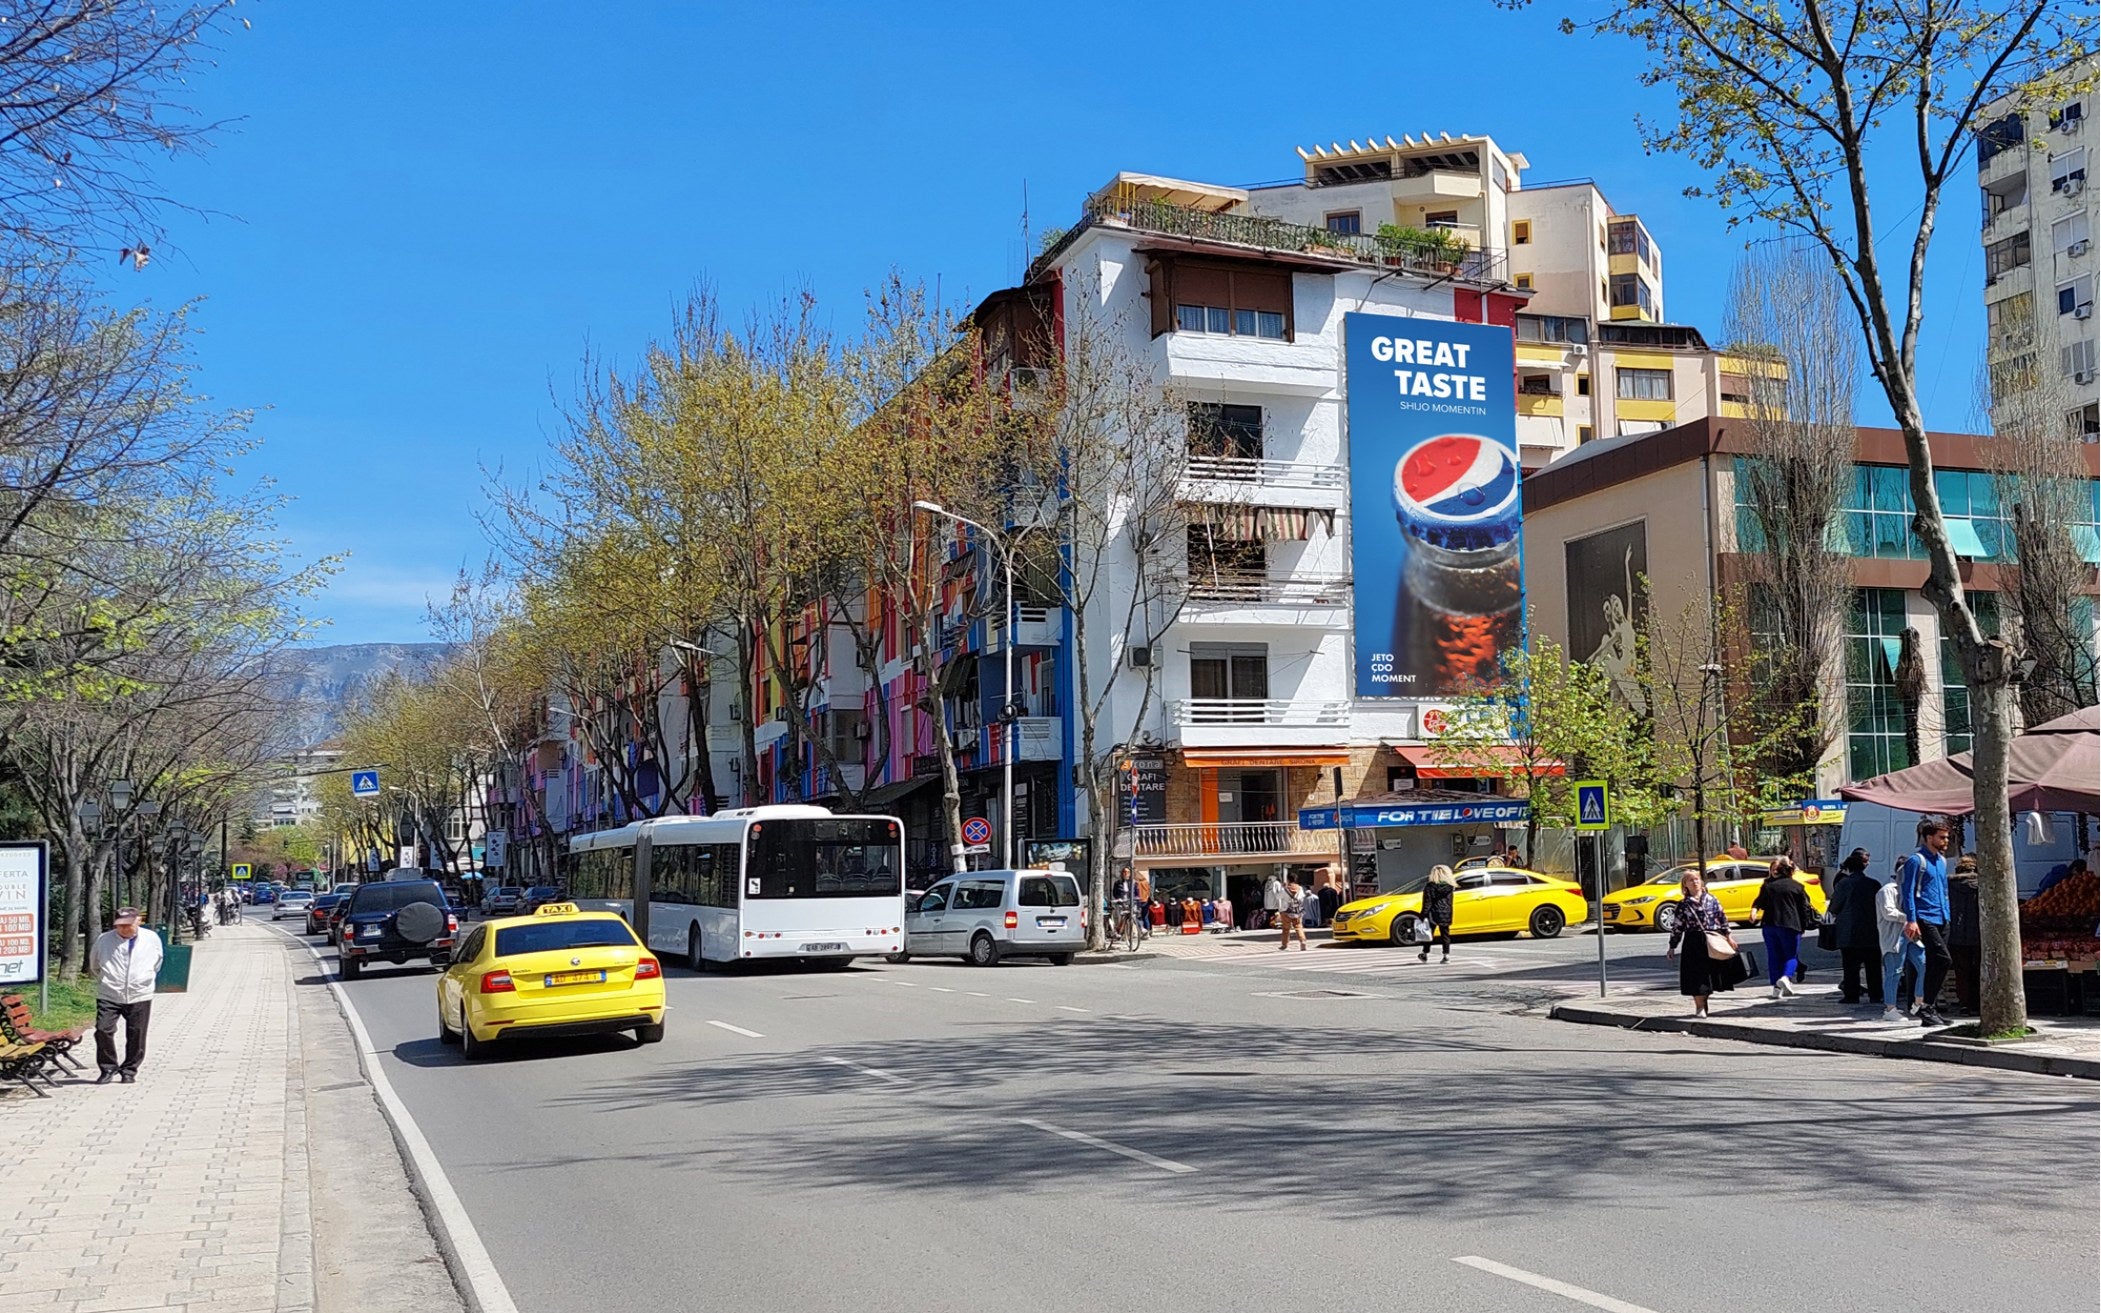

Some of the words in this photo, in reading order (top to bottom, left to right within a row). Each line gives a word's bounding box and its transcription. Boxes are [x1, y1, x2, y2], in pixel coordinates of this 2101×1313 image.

[1371, 336, 1470, 368] GREAT
[1394, 370, 1486, 401] TASTE
[1400, 401, 1431, 413] SHIJO
[1432, 403, 1487, 416] MOMENTIN
[1371, 653, 1395, 662] JETO
[1371, 663, 1394, 675] ÇDO
[1371, 674, 1417, 683] MOMENT
[1377, 810, 1415, 822] FOR
[1497, 806, 1519, 818] OF
[542, 904, 573, 914] TAXI
